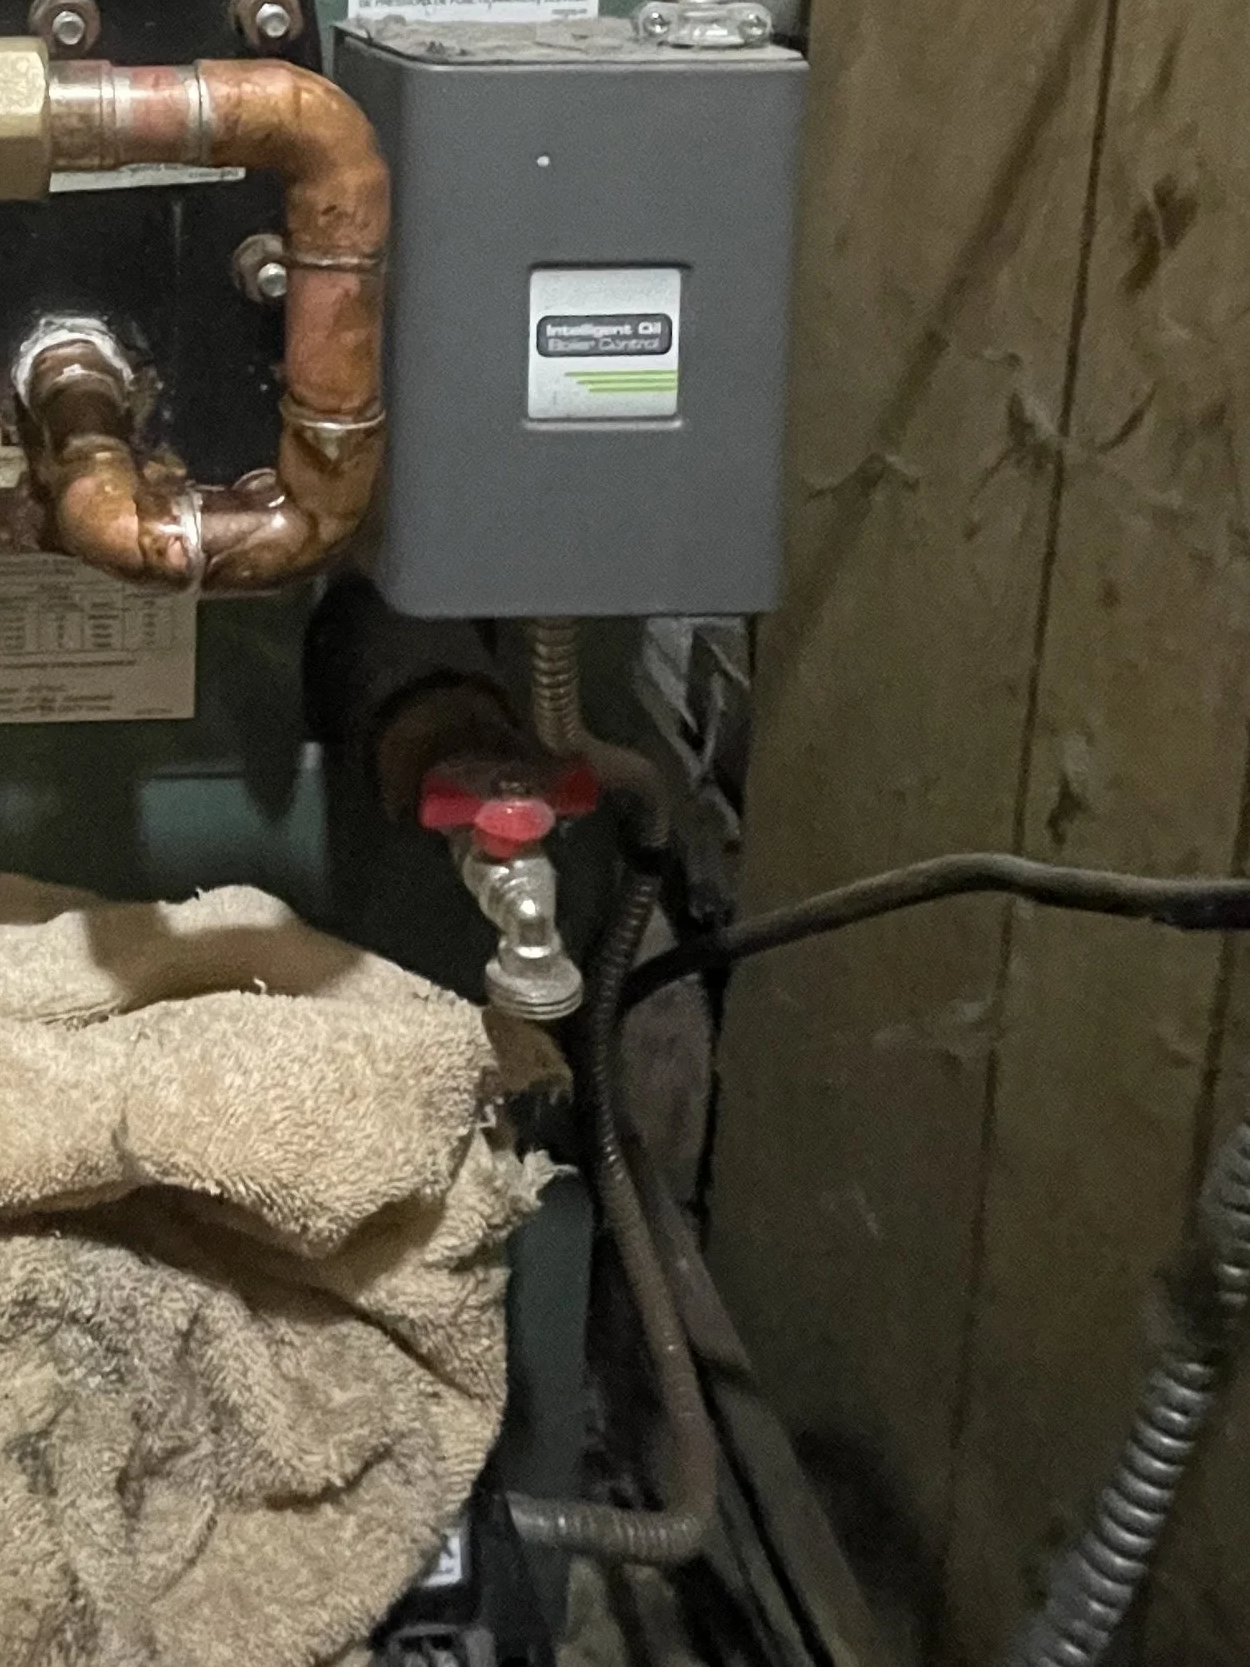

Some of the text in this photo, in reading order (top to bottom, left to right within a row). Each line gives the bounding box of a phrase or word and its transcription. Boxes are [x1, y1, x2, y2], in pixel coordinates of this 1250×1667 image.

[545, 321, 662, 338] Intelligent Oil
[547, 337, 660, 352] Boiler Control
